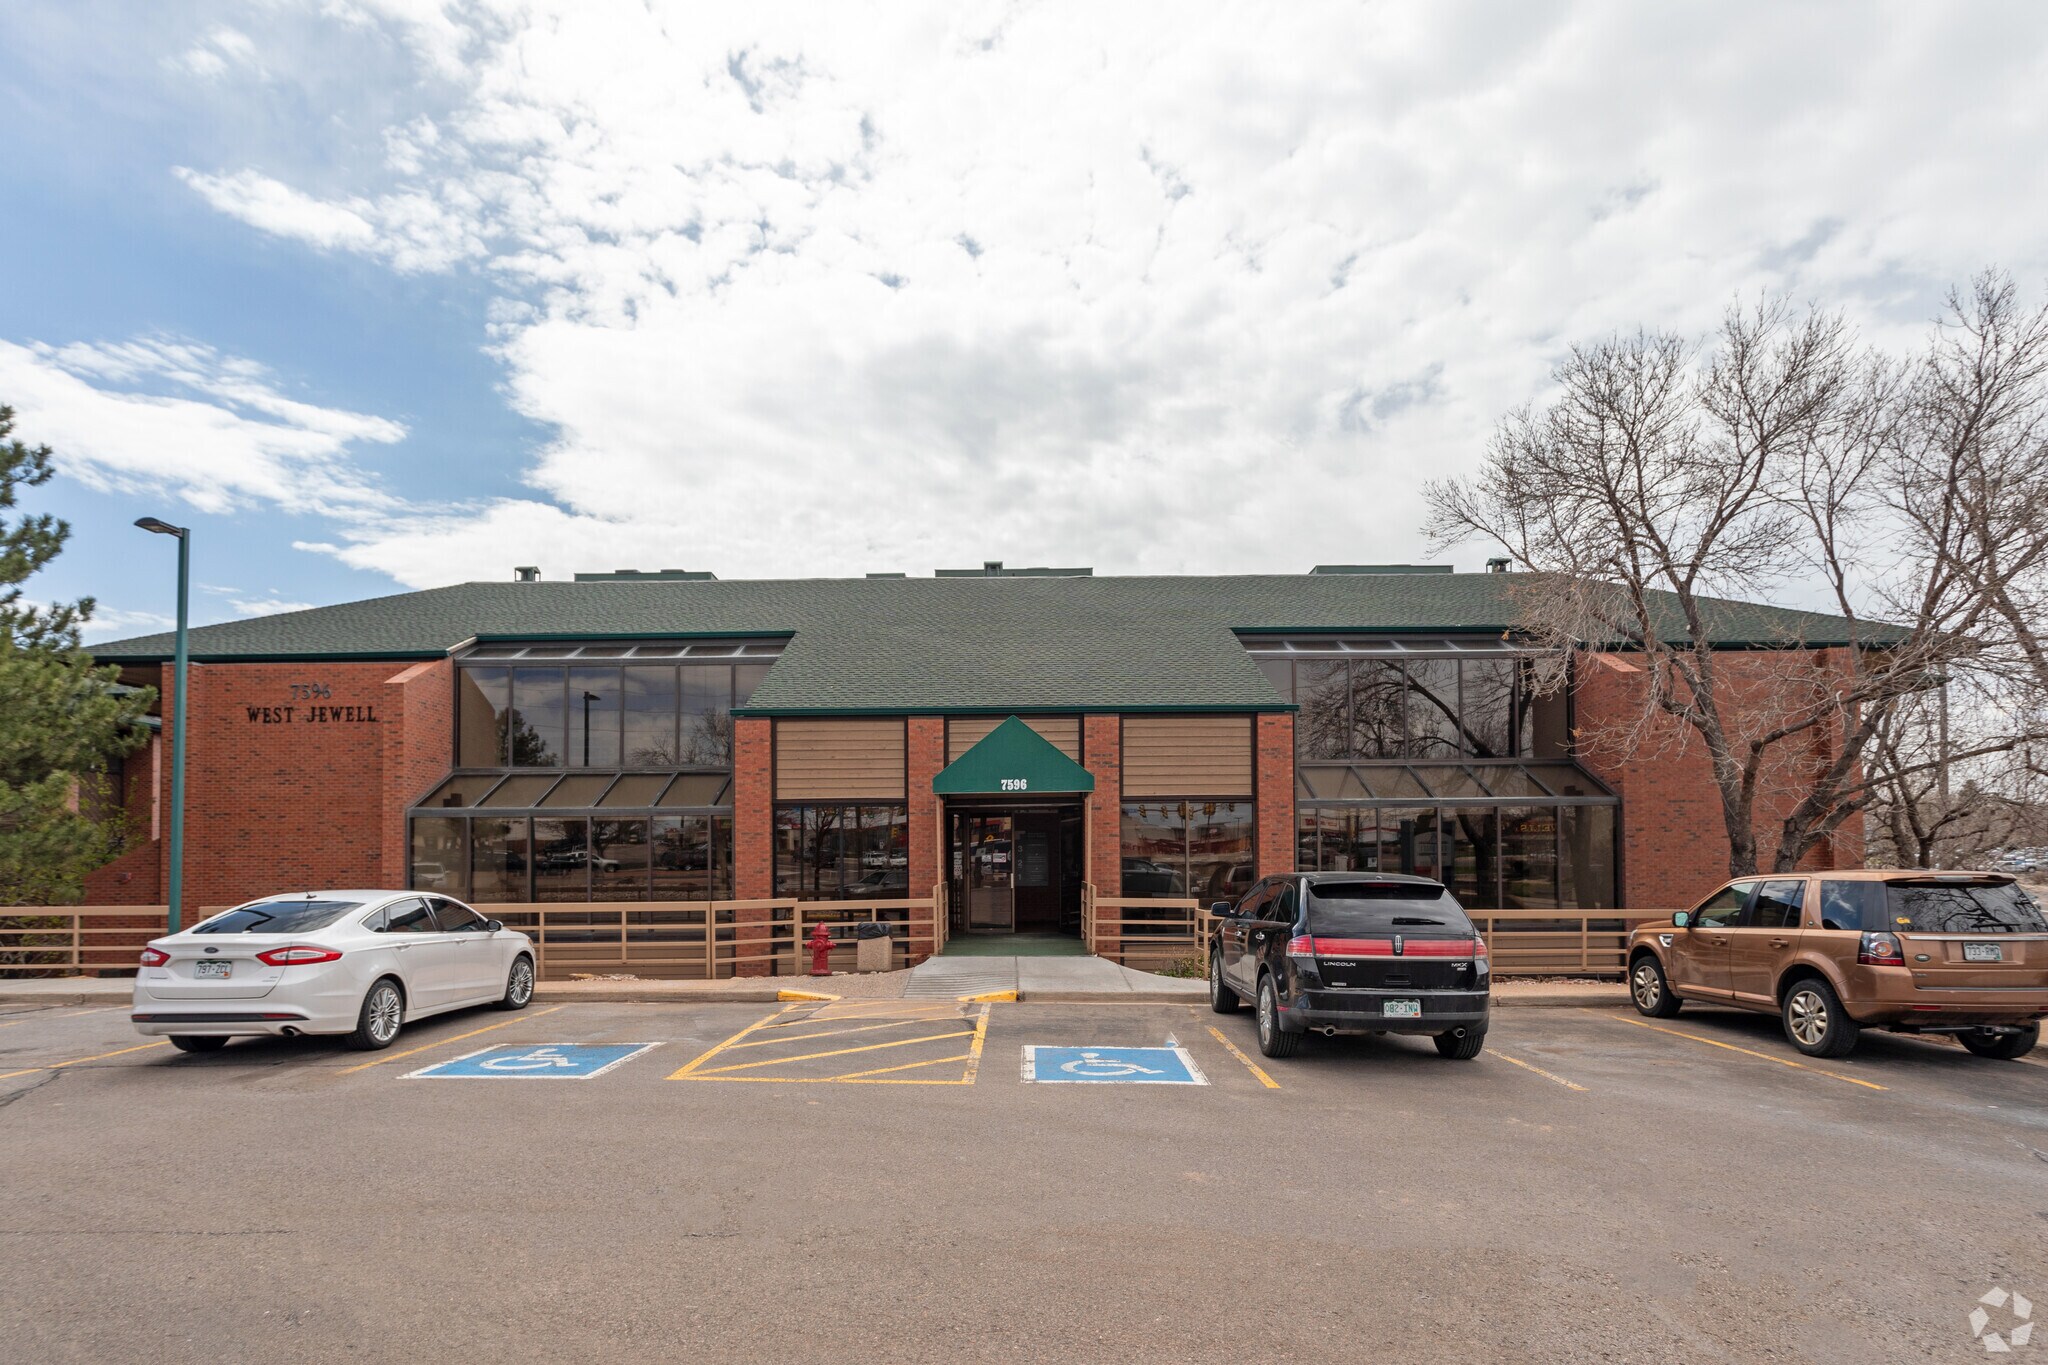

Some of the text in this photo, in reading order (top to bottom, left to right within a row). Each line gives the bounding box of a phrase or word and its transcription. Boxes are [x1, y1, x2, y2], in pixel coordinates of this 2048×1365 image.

[290, 683, 332, 700] 7596
[246, 705, 380, 724] WEST JEWELL
[1000, 778, 1027, 791] 7596
